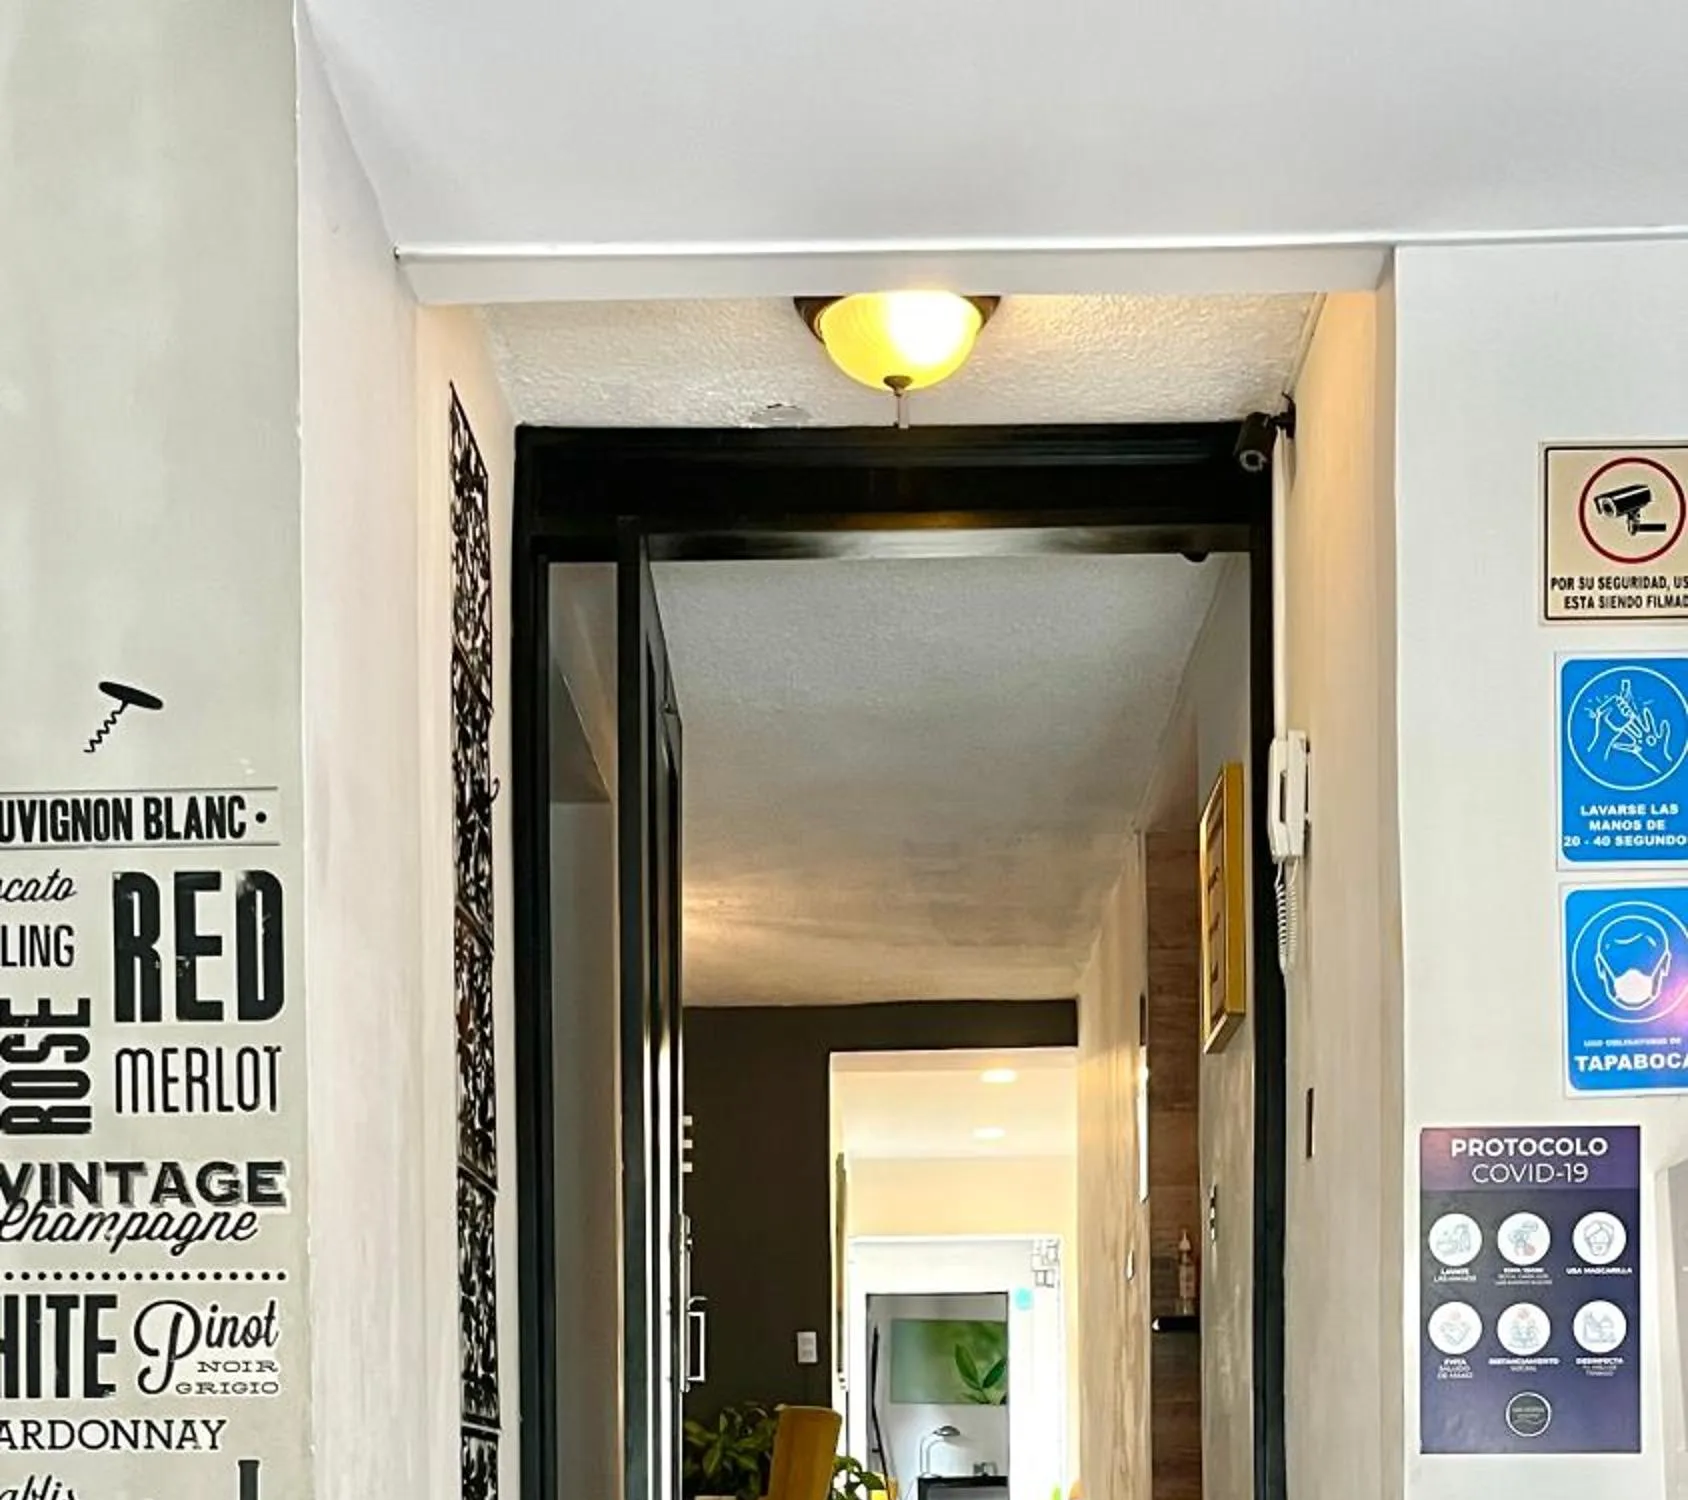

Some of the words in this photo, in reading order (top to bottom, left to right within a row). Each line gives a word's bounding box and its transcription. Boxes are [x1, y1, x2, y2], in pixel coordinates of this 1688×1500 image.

[1552, 576, 1575, 590] POR
[1578, 576, 1595, 590] SU
[1598, 575, 1671, 591] SEGURIDAD,
[1564, 595, 1595, 609] ESTA
[1598, 595, 1643, 609] SIENDO
[143, 796, 246, 840] BLANC
[1580, 804, 1647, 816] LAVARSE
[1651, 803, 1679, 815] LAS
[1589, 820, 1642, 831] MANOS
[1647, 819, 1666, 830] DE
[1563, 836, 1581, 847] 20
[1593, 835, 1611, 847] 40
[1615, 834, 1687, 847] SEGUNDO
[0, 868, 78, 902] cato
[1, 924, 75, 967] LING
[113, 871, 285, 1022] RED
[0, 998, 92, 1134] ROSE
[115, 1047, 282, 1113] MERLOT
[1451, 1137, 1608, 1156] PROTOCOLO
[0, 1161, 286, 1208] VINTAGE
[1472, 1163, 1589, 1183] COVID-19
[0, 1198, 258, 1256] Champagne
[134, 1300, 279, 1394] Pinot
[197, 1361, 278, 1373] NOIR
[175, 1382, 279, 1394] GRIGIO
